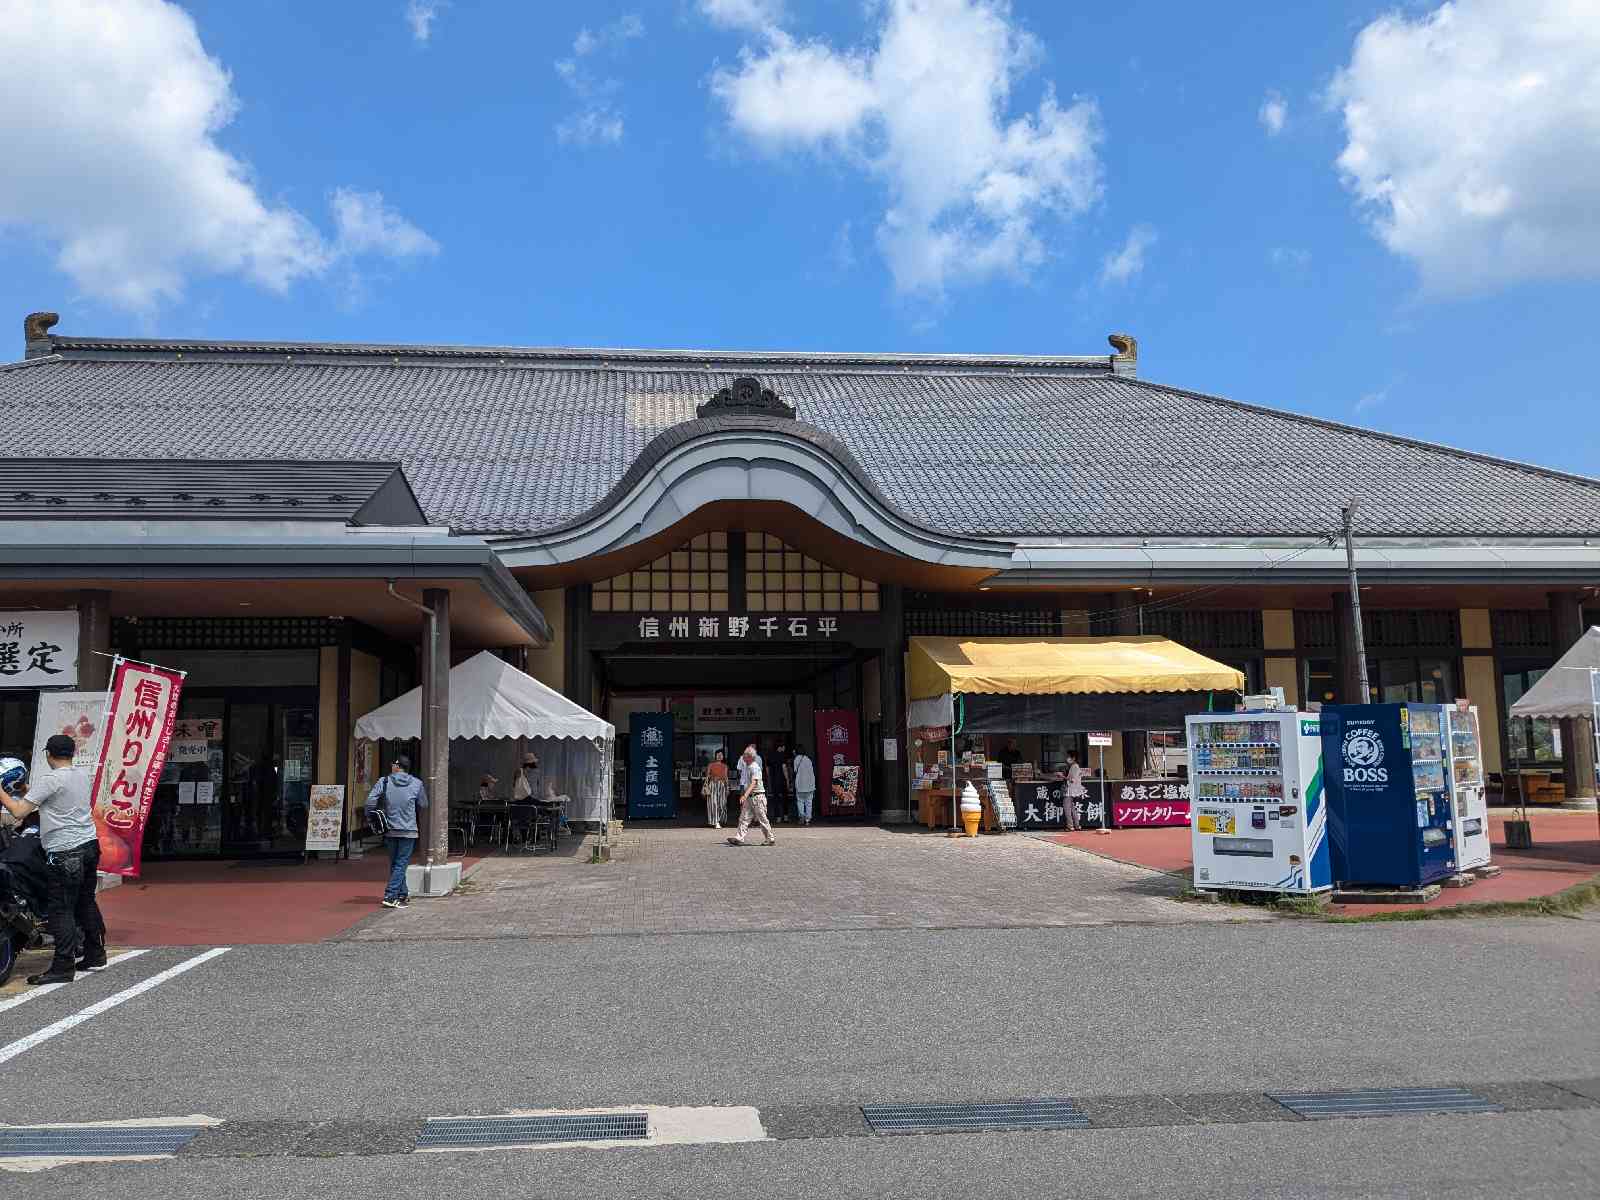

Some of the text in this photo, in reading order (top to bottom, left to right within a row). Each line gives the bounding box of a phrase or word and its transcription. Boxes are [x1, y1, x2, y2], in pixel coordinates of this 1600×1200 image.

[638, 617, 838, 638] 信州新野千石平
[1346, 729, 1379, 740] COFFEE
[104, 678, 163, 829] 信州りんご
[1344, 768, 1388, 782] BOSS
